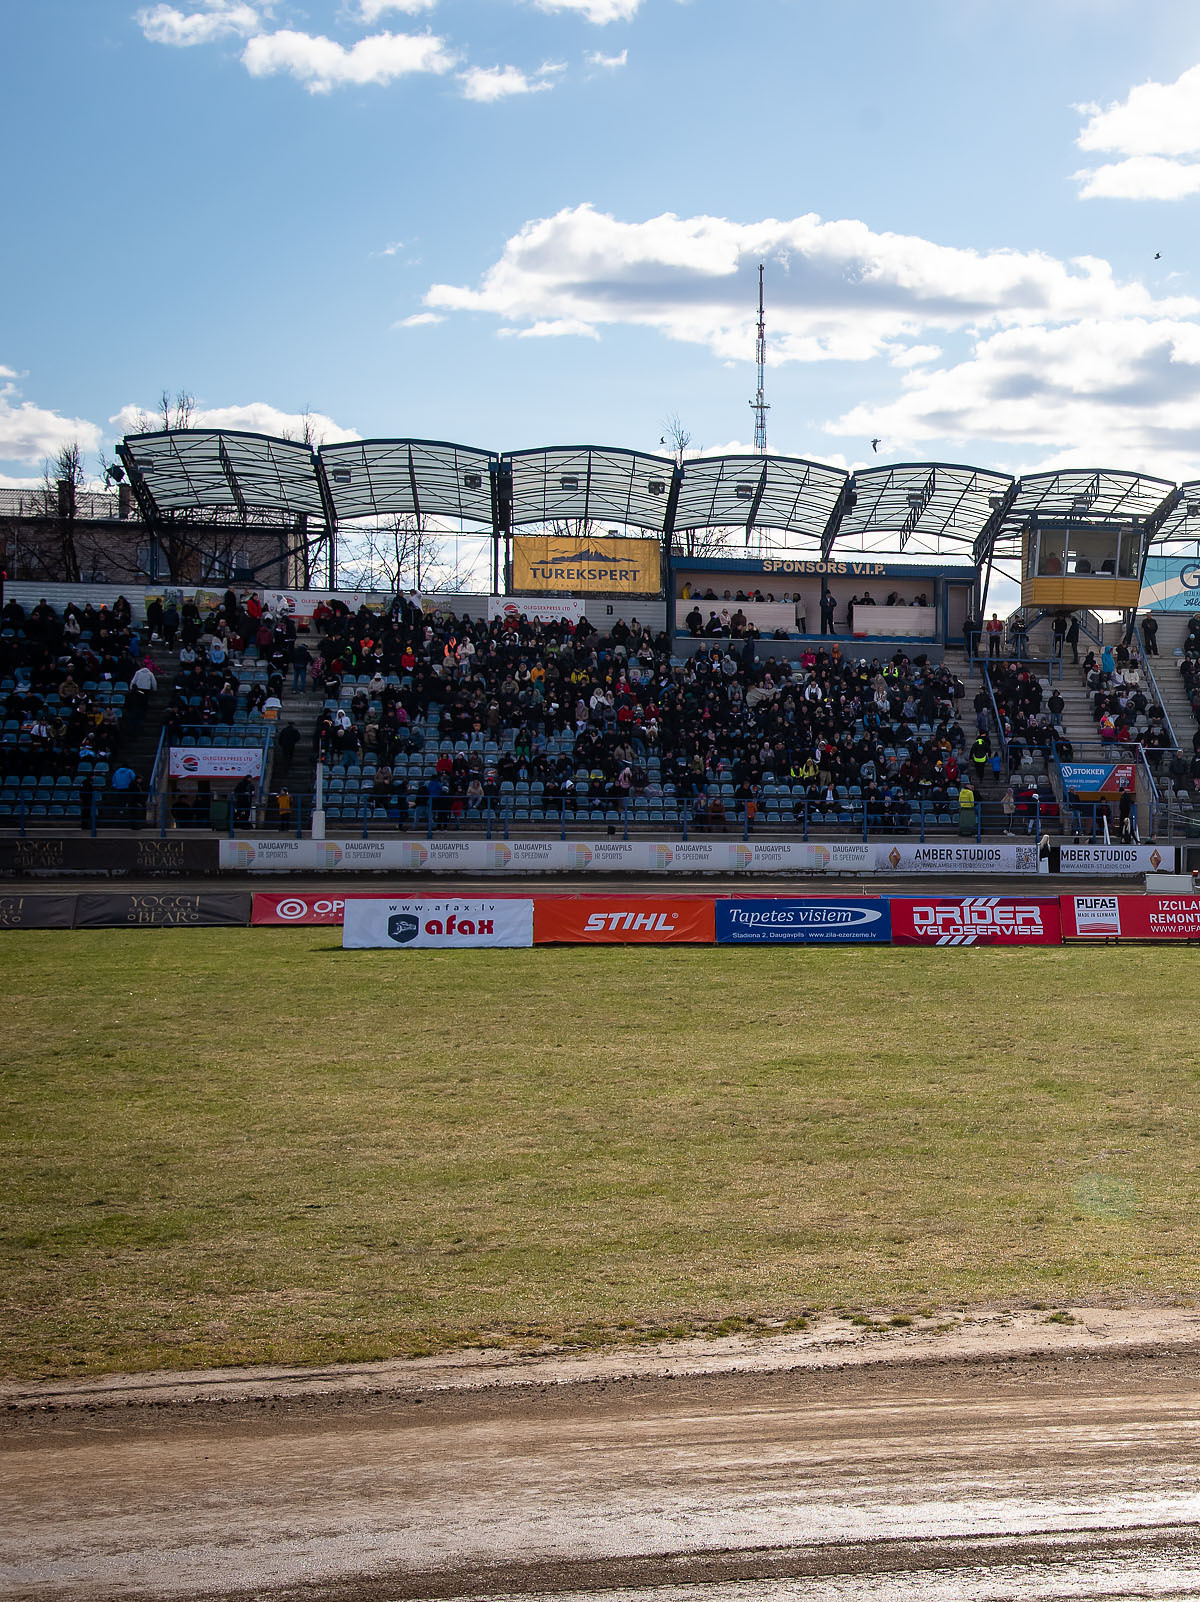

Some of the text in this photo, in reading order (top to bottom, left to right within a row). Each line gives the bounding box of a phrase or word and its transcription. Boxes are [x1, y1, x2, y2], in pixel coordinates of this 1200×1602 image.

[763, 560, 886, 575] SPONSORS V.I.P.
[530, 567, 640, 581] TUREKSPERT
[606, 605, 613, 615] D
[1073, 768, 1105, 776] STOKKER
[258, 842, 298, 850] DAUGAVPILS
[915, 849, 1001, 860] AMBER STUDIOS
[1061, 850, 1138, 861] MBER STUDIOS
[129, 895, 200, 908] YOGGI
[389, 903, 495, 911] www.afax.lv
[1076, 899, 1116, 908] PUFAS
[138, 912, 188, 923] BEAR
[729, 908, 852, 927] Tapetes visiem
[912, 905, 1043, 925] DRIDER
[425, 914, 494, 935] afax
[584, 912, 675, 931] STIHL
[914, 925, 1044, 935] VELOSERVISS
